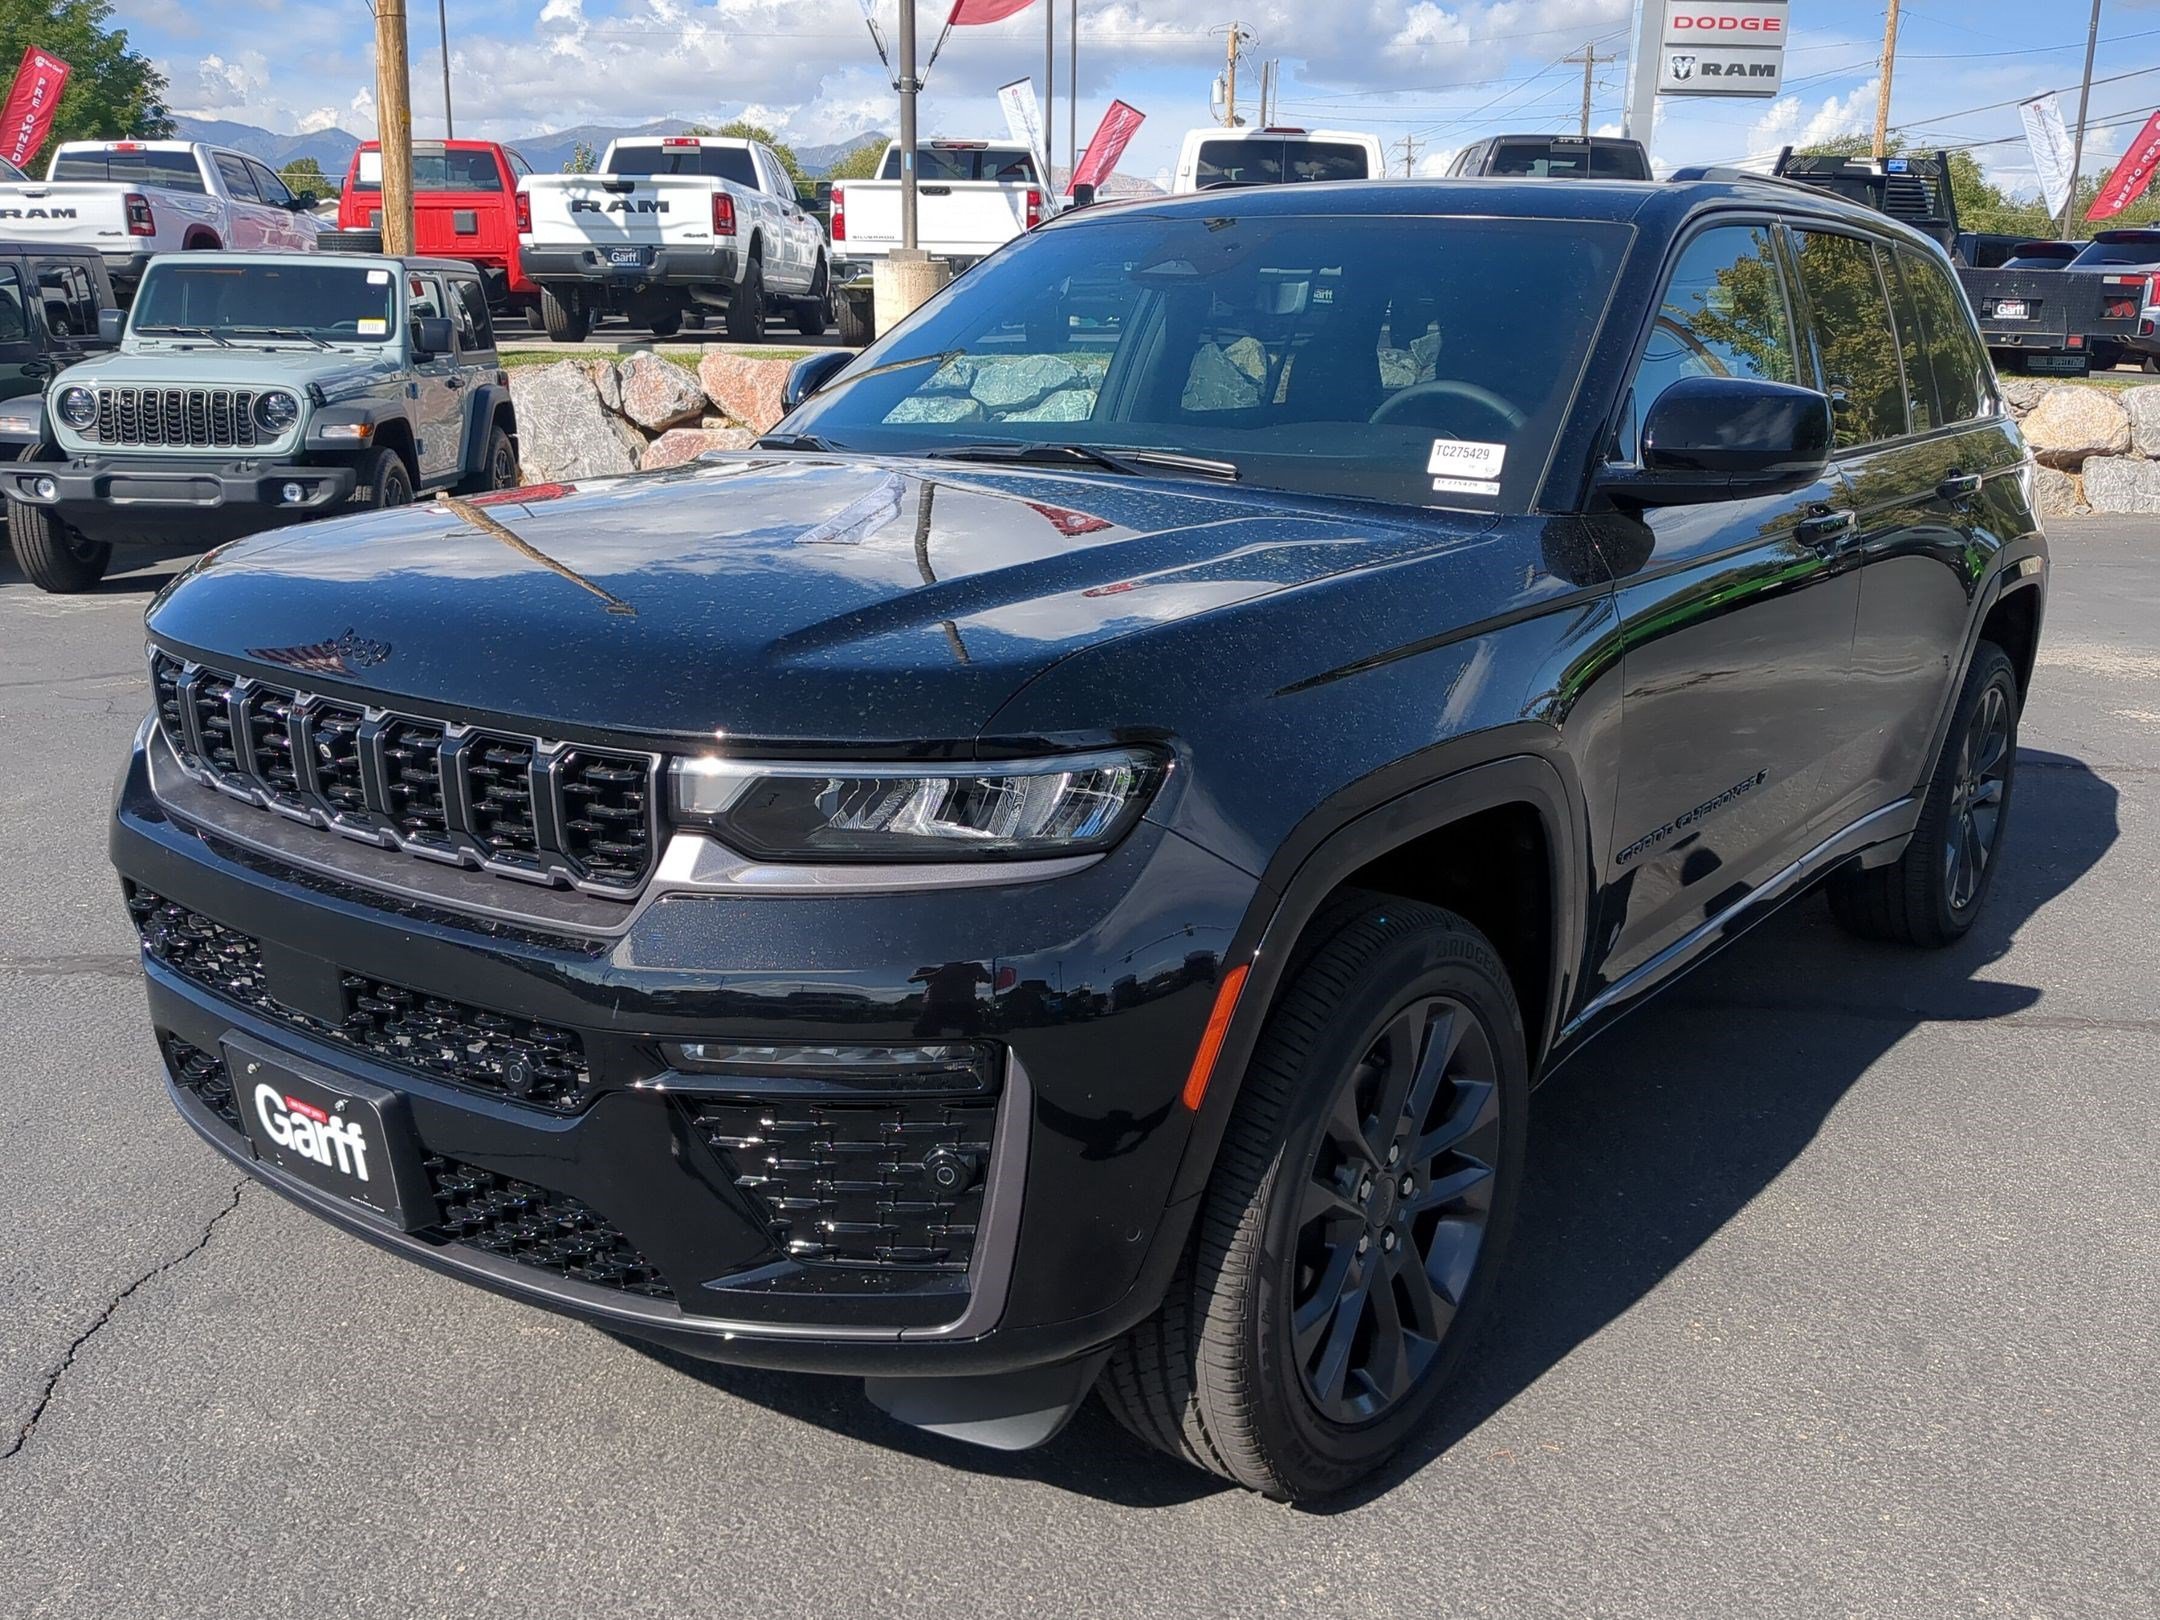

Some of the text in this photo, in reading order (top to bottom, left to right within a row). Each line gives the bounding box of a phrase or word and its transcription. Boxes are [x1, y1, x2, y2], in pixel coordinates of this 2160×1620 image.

[1673, 16, 1782, 31] DODGE
[1701, 63, 1777, 77] RAM
[11, 77, 46, 162] PRE OWNED
[2113, 168, 2142, 209] OWNED
[0, 208, 77, 219] RAM
[571, 200, 670, 213] RAM
[611, 251, 637, 263] Garff
[1997, 303, 2026, 315] Garff
[1436, 445, 1490, 460] TC275429
[321, 625, 394, 668] Jeep
[254, 1083, 369, 1182] Garff
